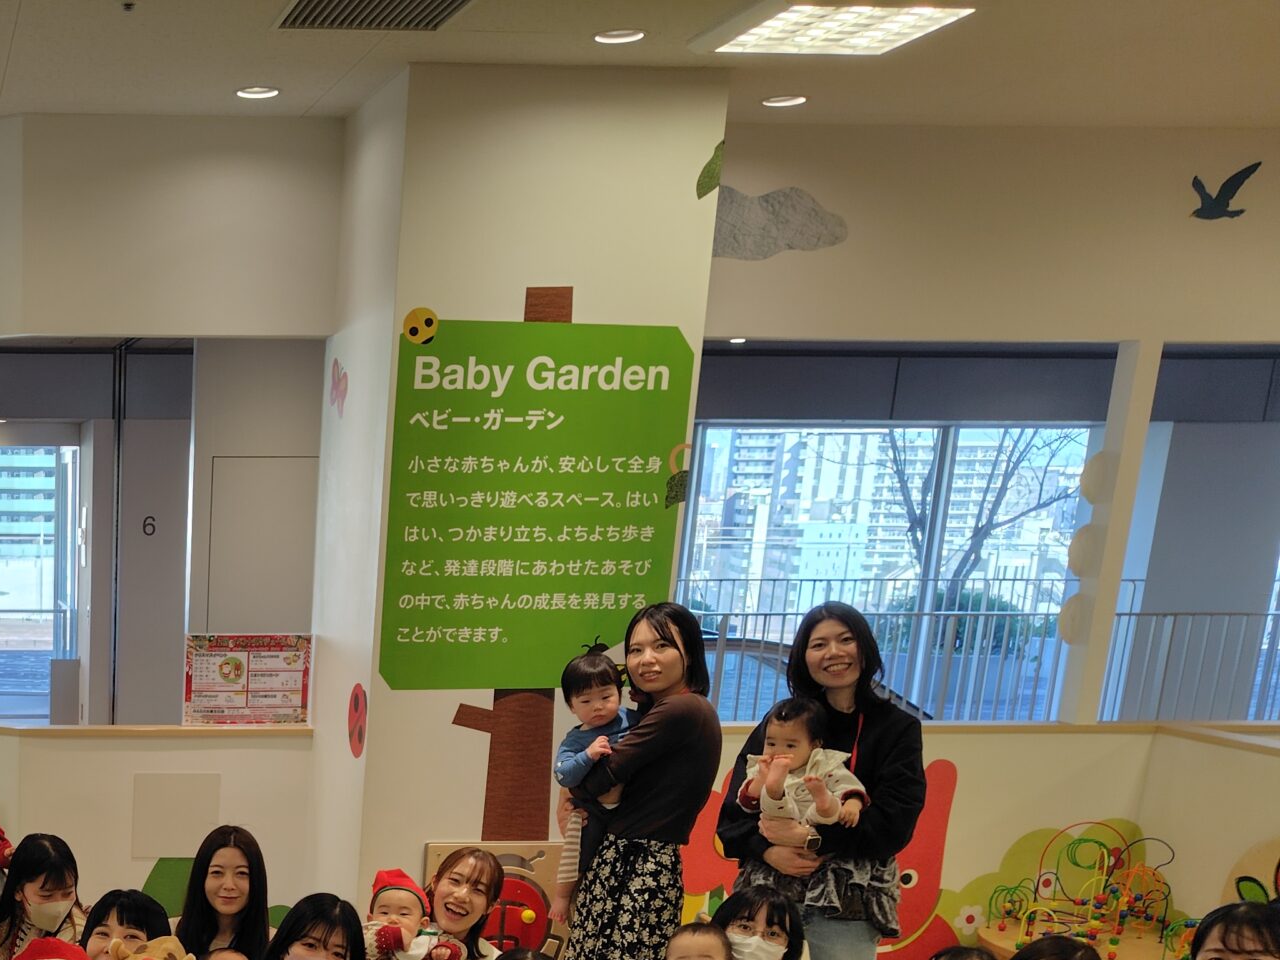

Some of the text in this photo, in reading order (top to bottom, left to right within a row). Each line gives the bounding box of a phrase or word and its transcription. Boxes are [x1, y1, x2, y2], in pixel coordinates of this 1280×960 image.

[413, 355, 671, 398] Baby Garden
[409, 407, 565, 431] ベビー・ガーデン
[407, 455, 663, 474] 小さな赤ちゃんが、安心して全身
[405, 490, 659, 509] で思いっきり遊べるスペース。はい
[142, 515, 157, 536] 6
[403, 524, 656, 543] はい、つかまり立ち、よちよち歩き
[401, 558, 652, 577] など、発達段階にあわせたあそび
[398, 592, 648, 610] の中で、赤ちゃんの成長を発見する
[396, 626, 509, 644] ことができます。
